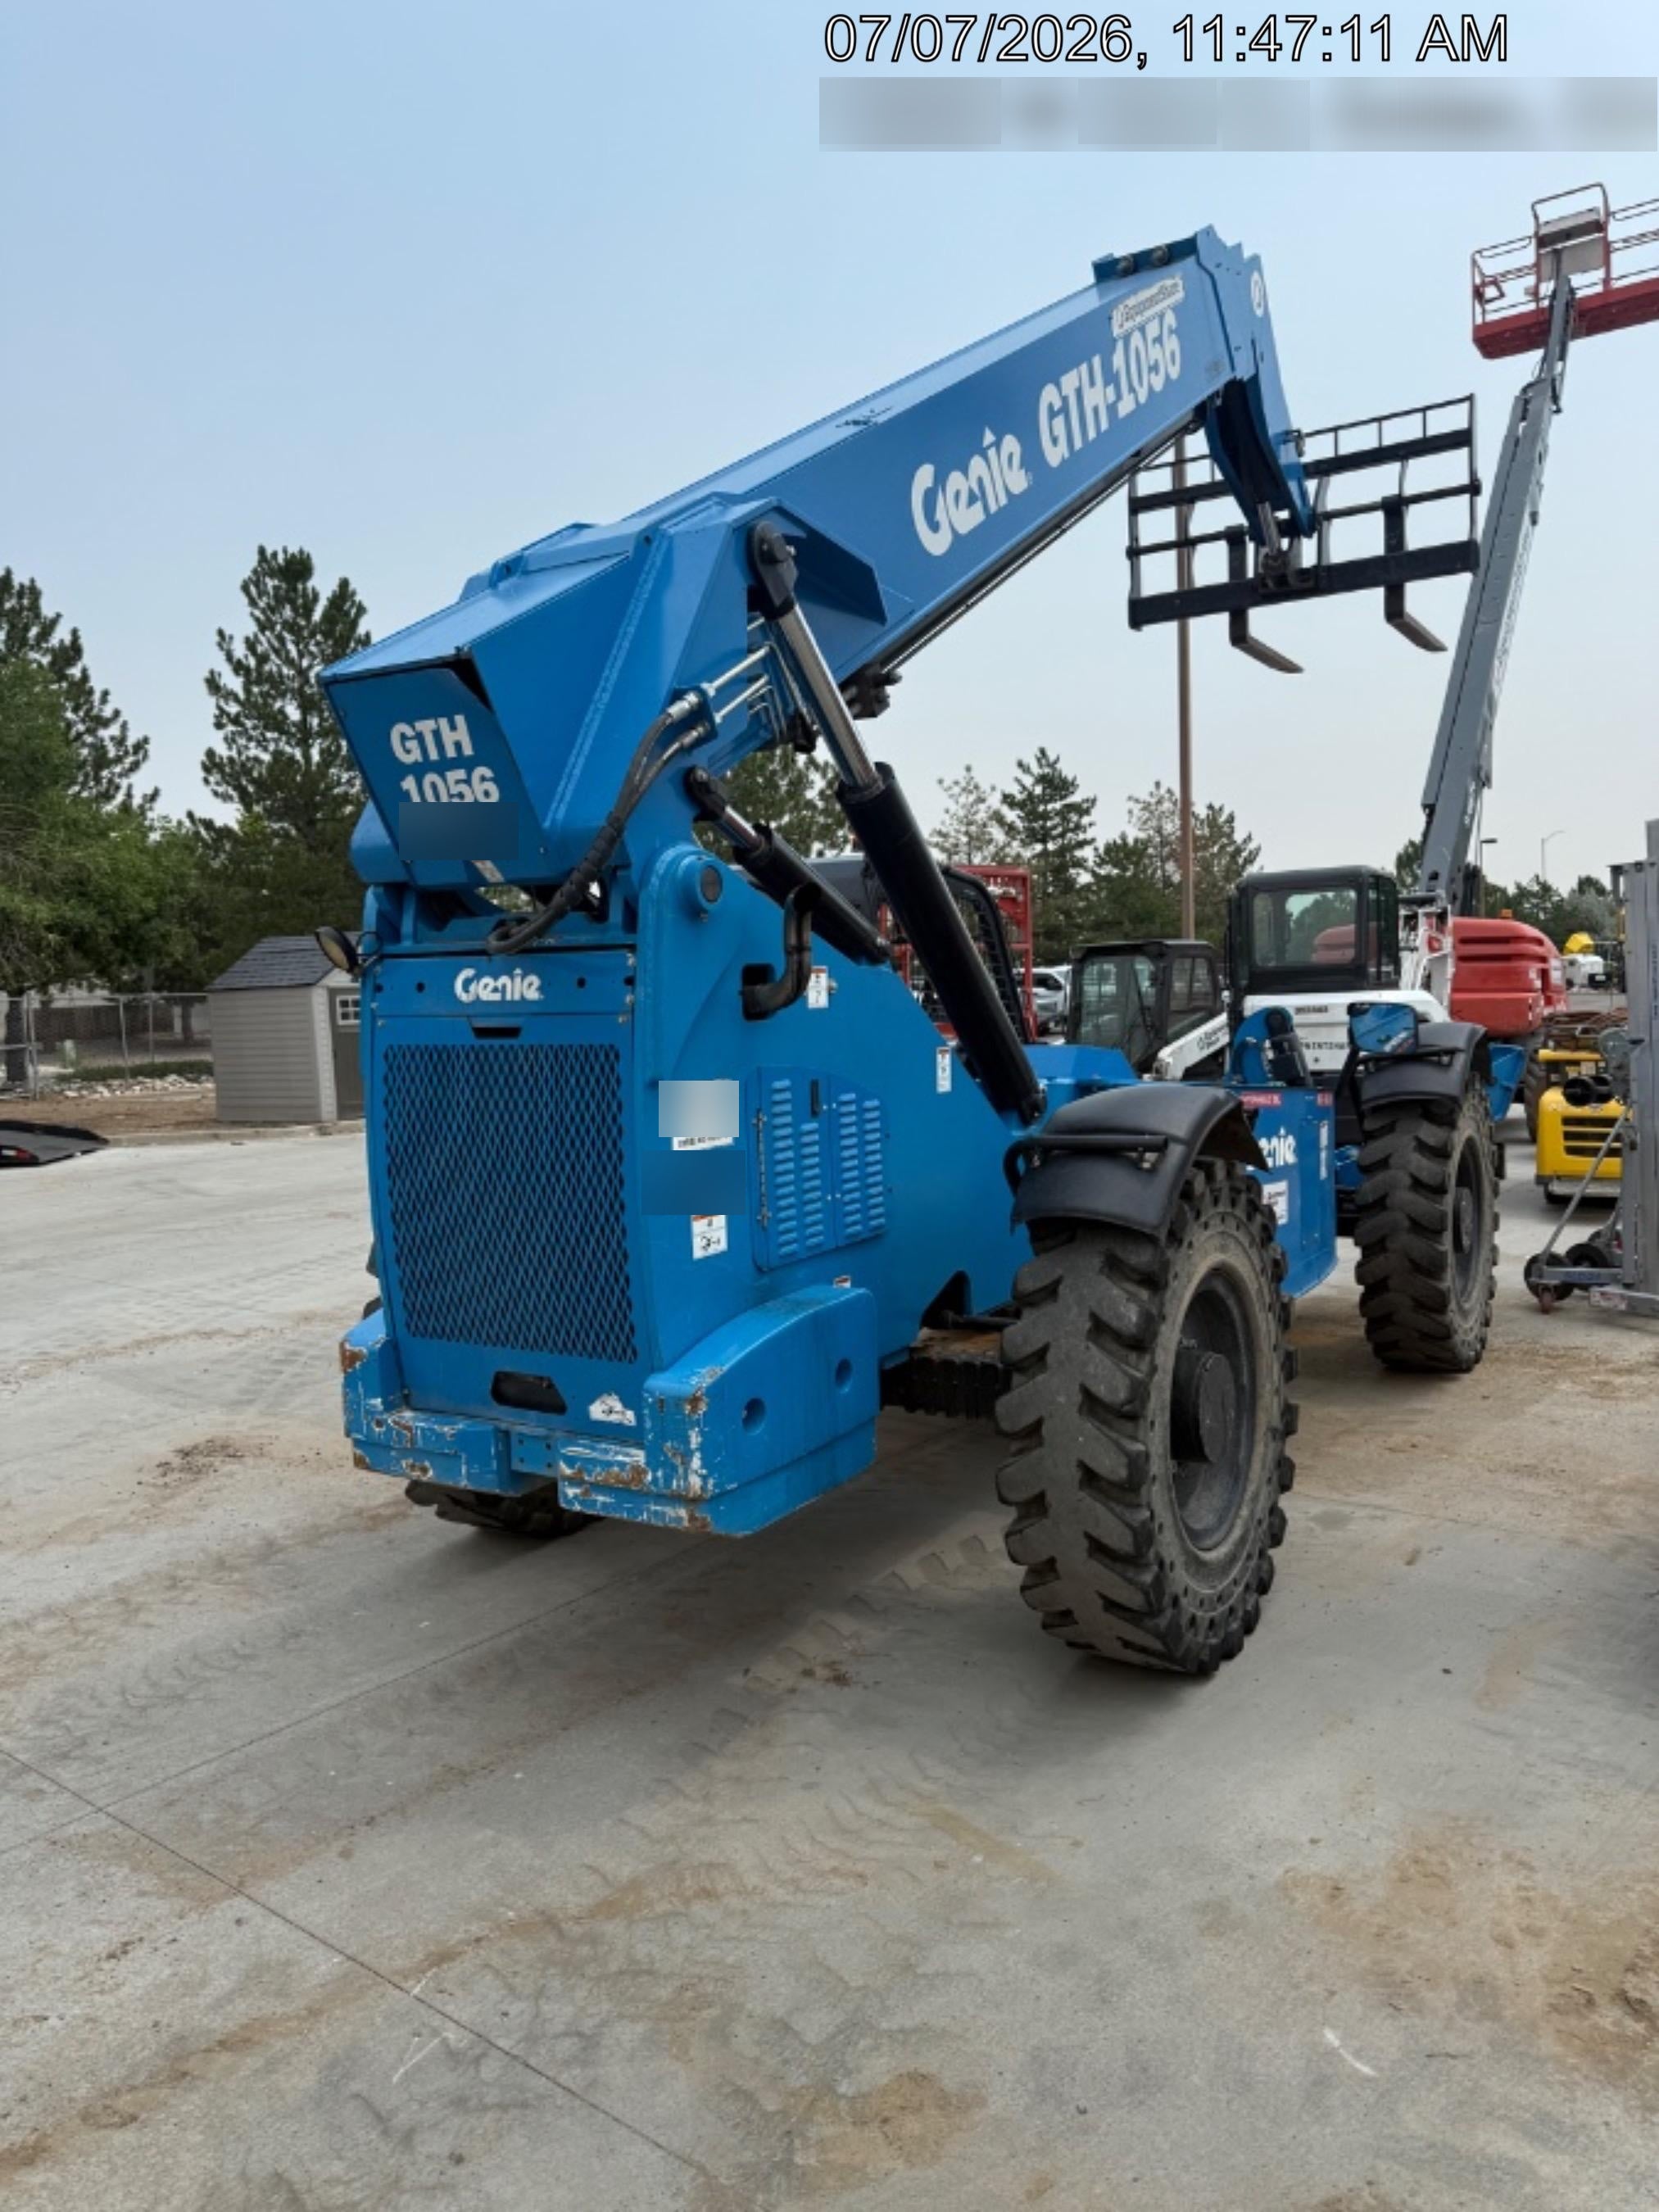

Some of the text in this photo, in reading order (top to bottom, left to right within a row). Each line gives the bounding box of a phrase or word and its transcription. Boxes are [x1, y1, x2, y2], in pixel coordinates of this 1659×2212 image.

[911, 307, 1181, 556] Genie GTH-1056
[390, 714, 474, 764] GTH
[400, 766, 500, 802] 1056
[455, 968, 542, 1004] Genie
[1246, 1126, 1298, 1170] enie
